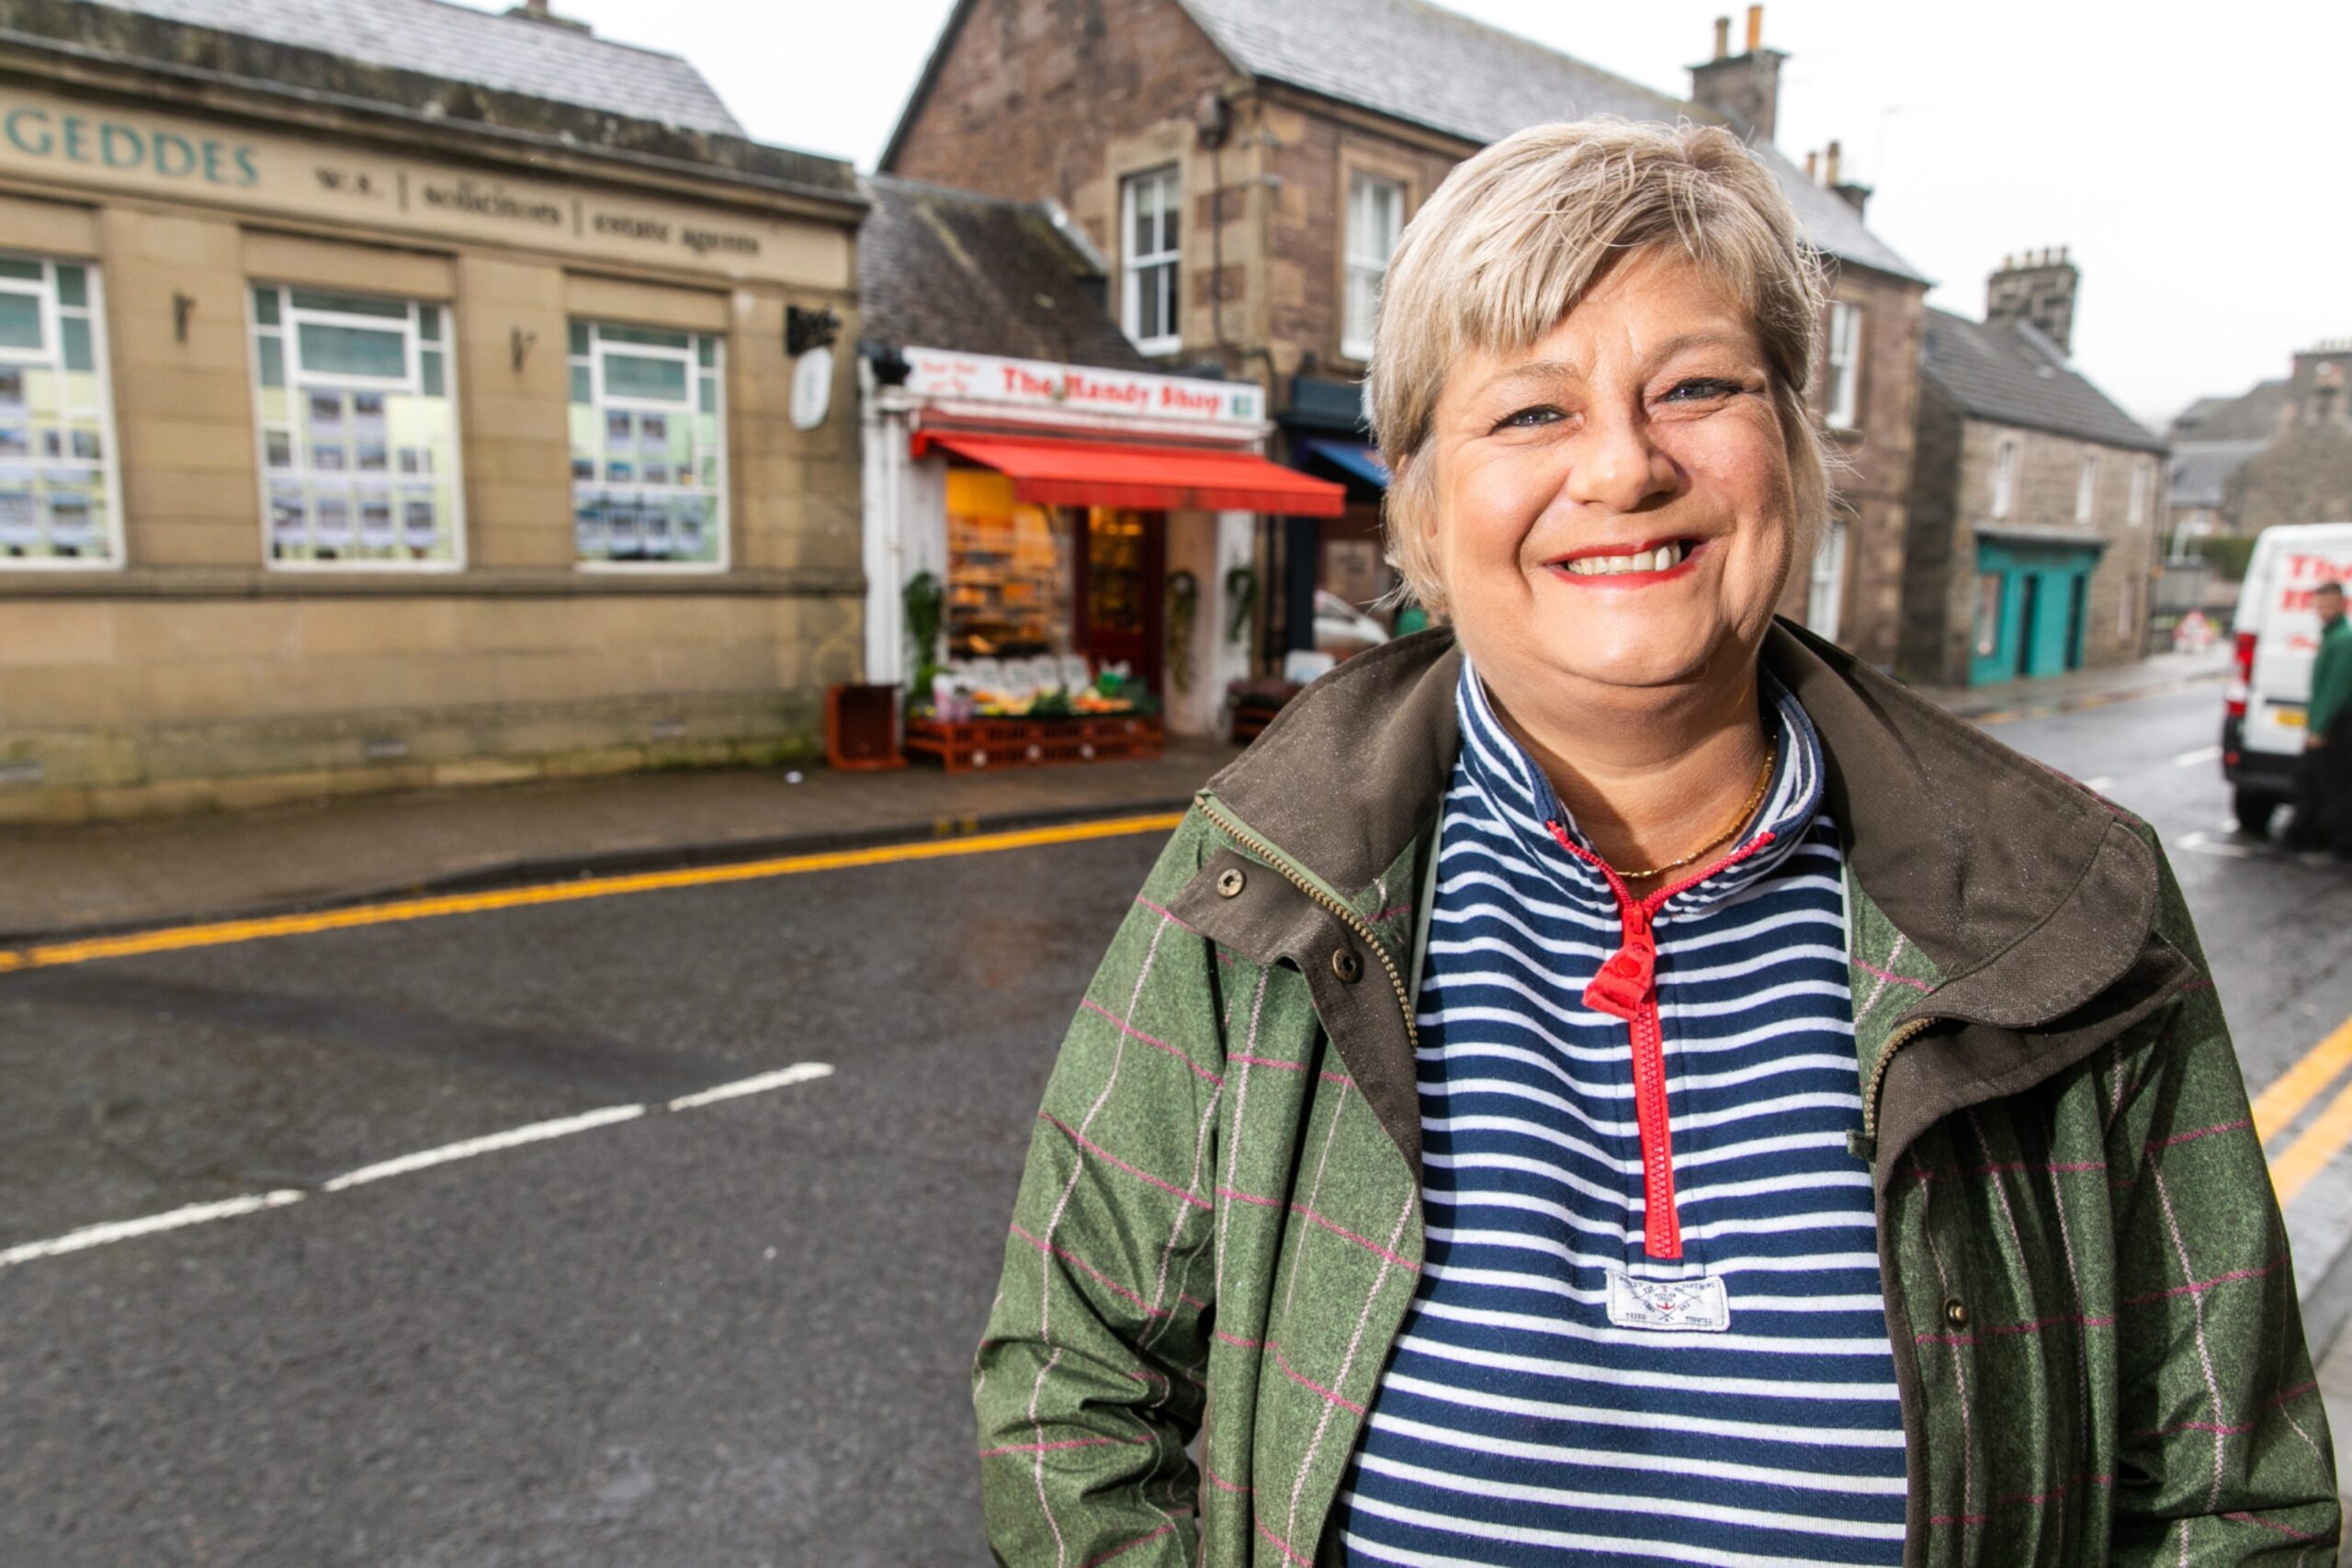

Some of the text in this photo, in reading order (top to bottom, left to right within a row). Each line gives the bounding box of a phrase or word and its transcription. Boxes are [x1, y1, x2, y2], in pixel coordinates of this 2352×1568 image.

[4, 106, 258, 187] GEDDES
[1001, 366, 1053, 399] The
[1064, 372, 1151, 412] Handy
[1159, 384, 1222, 421] Shop
